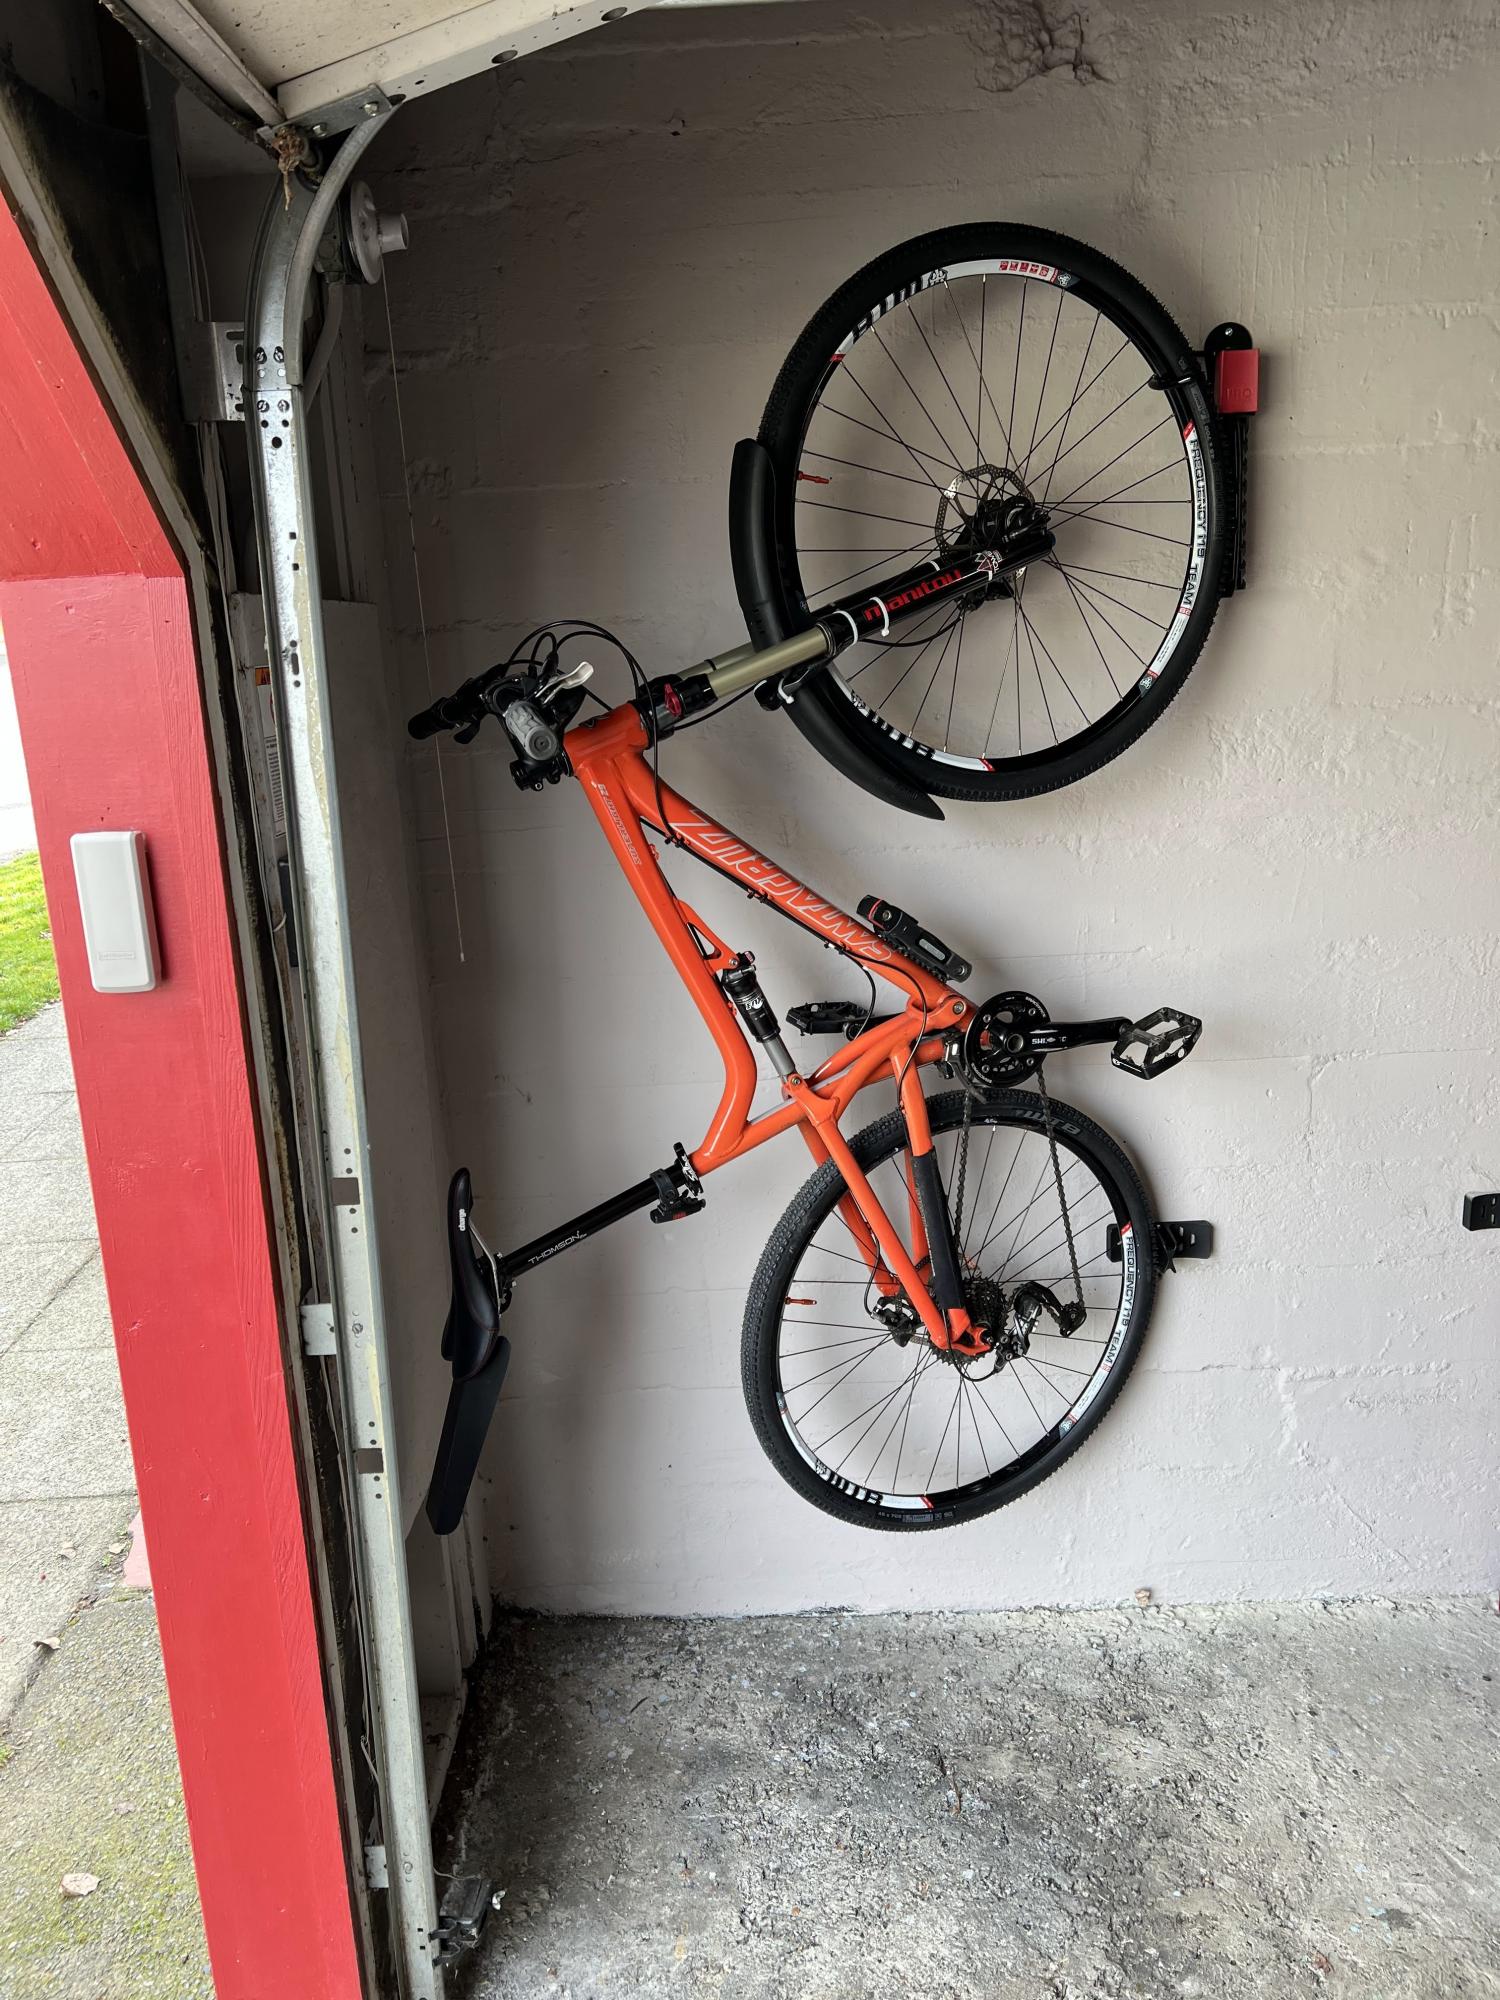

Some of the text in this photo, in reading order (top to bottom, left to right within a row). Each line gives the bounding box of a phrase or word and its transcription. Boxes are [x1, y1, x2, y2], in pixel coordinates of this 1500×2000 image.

[1190, 439, 1207, 532] FREQUENCY
[863, 568, 962, 621] manitou
[1183, 563, 1199, 606] TEAM
[528, 1230, 581, 1264] THOMSON
[1124, 1235, 1136, 1306] FREQUENCY
[1104, 1329, 1121, 1364] TEAM
